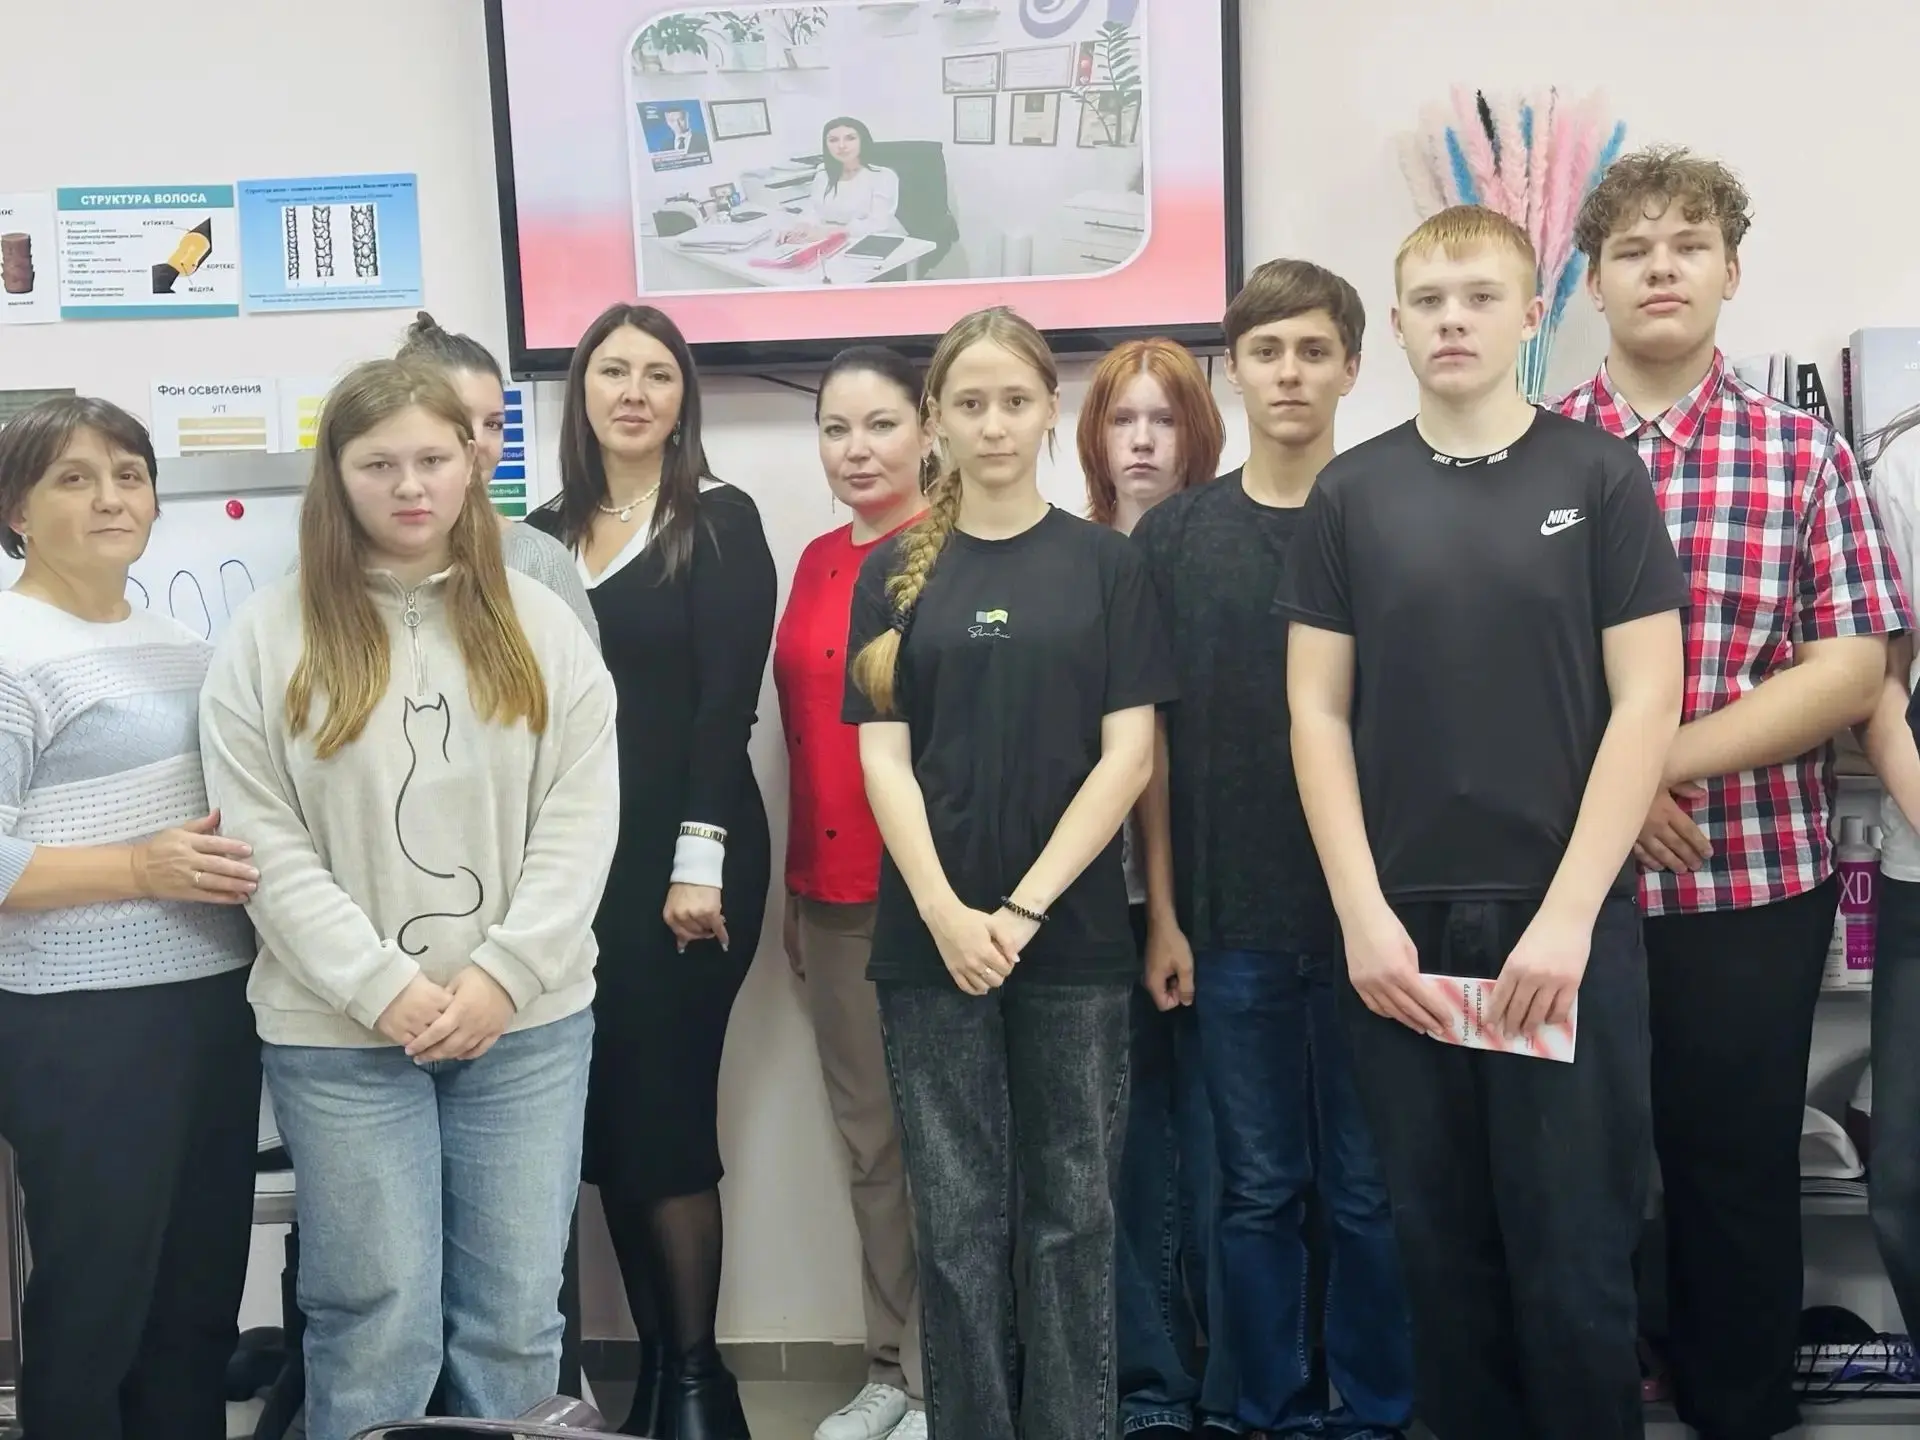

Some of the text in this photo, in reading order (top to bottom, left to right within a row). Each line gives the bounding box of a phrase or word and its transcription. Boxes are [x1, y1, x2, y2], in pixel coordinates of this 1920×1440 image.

[80, 192, 207, 206] СТРУКТУРА ВОЛОСА
[157, 384, 262, 396] Фон осветления
[1432, 449, 1509, 465] NIKE NIKE
[1547, 508, 1579, 524] NIKE
